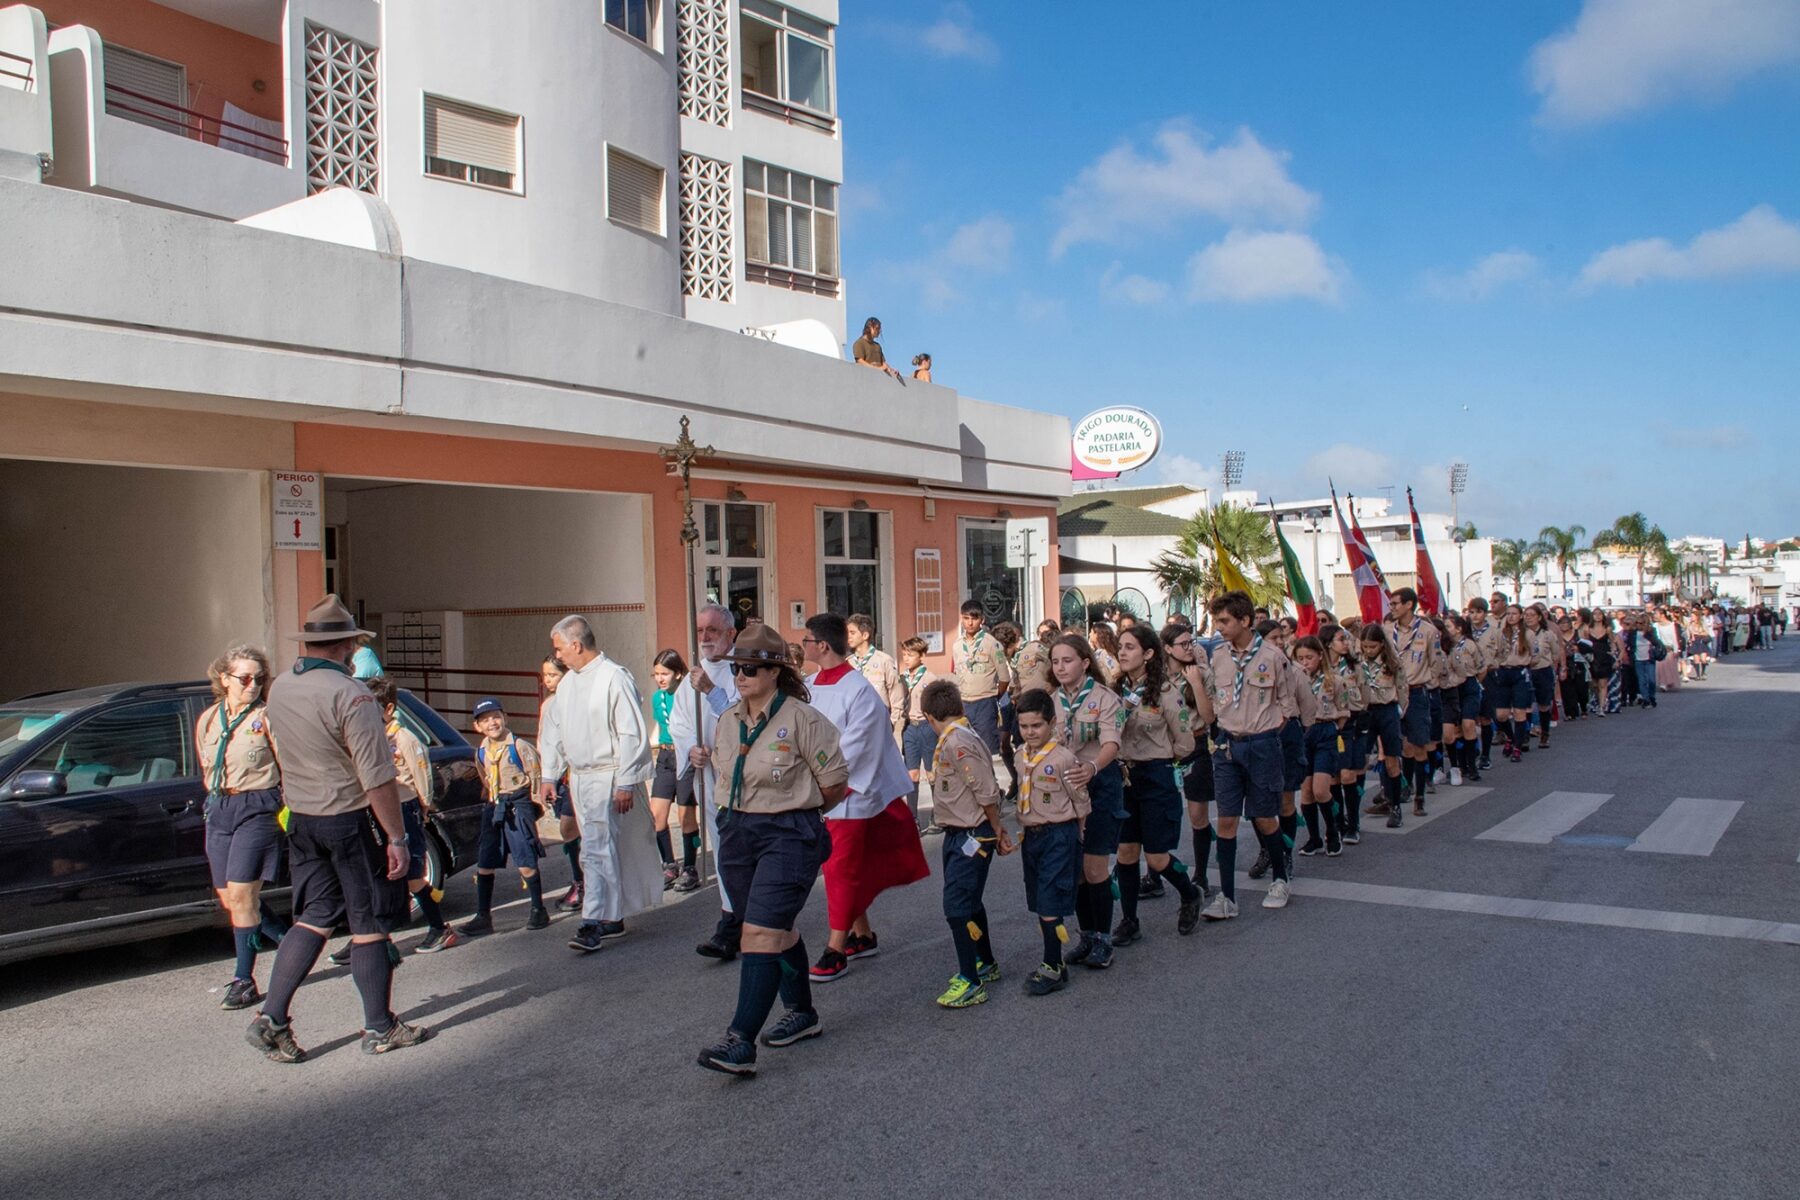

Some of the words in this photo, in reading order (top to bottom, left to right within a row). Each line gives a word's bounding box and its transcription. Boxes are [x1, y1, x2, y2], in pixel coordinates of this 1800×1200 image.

[1077, 417, 1102, 441] TRIGO
[1105, 413, 1152, 438] DOURADO
[1093, 431, 1135, 443] PADARIA
[1088, 441, 1142, 454] PASTELARIA
[276, 473, 315, 483] PERIGO
